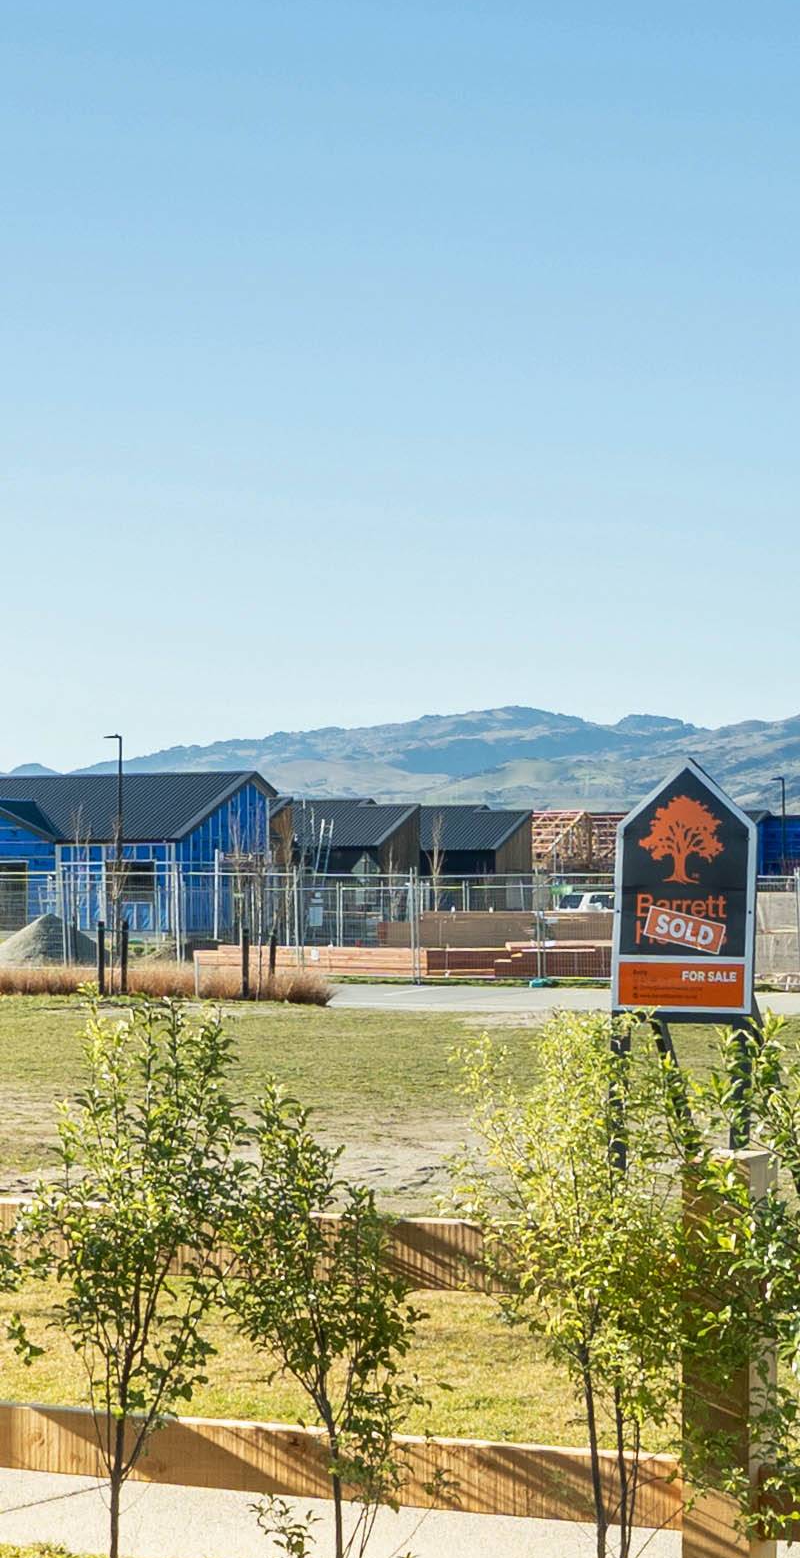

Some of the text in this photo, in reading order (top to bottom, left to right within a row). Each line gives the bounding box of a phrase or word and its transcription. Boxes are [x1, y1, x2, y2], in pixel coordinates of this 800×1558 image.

[636, 894, 727, 917] Barrett
[655, 914, 714, 945] SOLD
[681, 970, 705, 982] FOR
[708, 971, 737, 983] SALE
